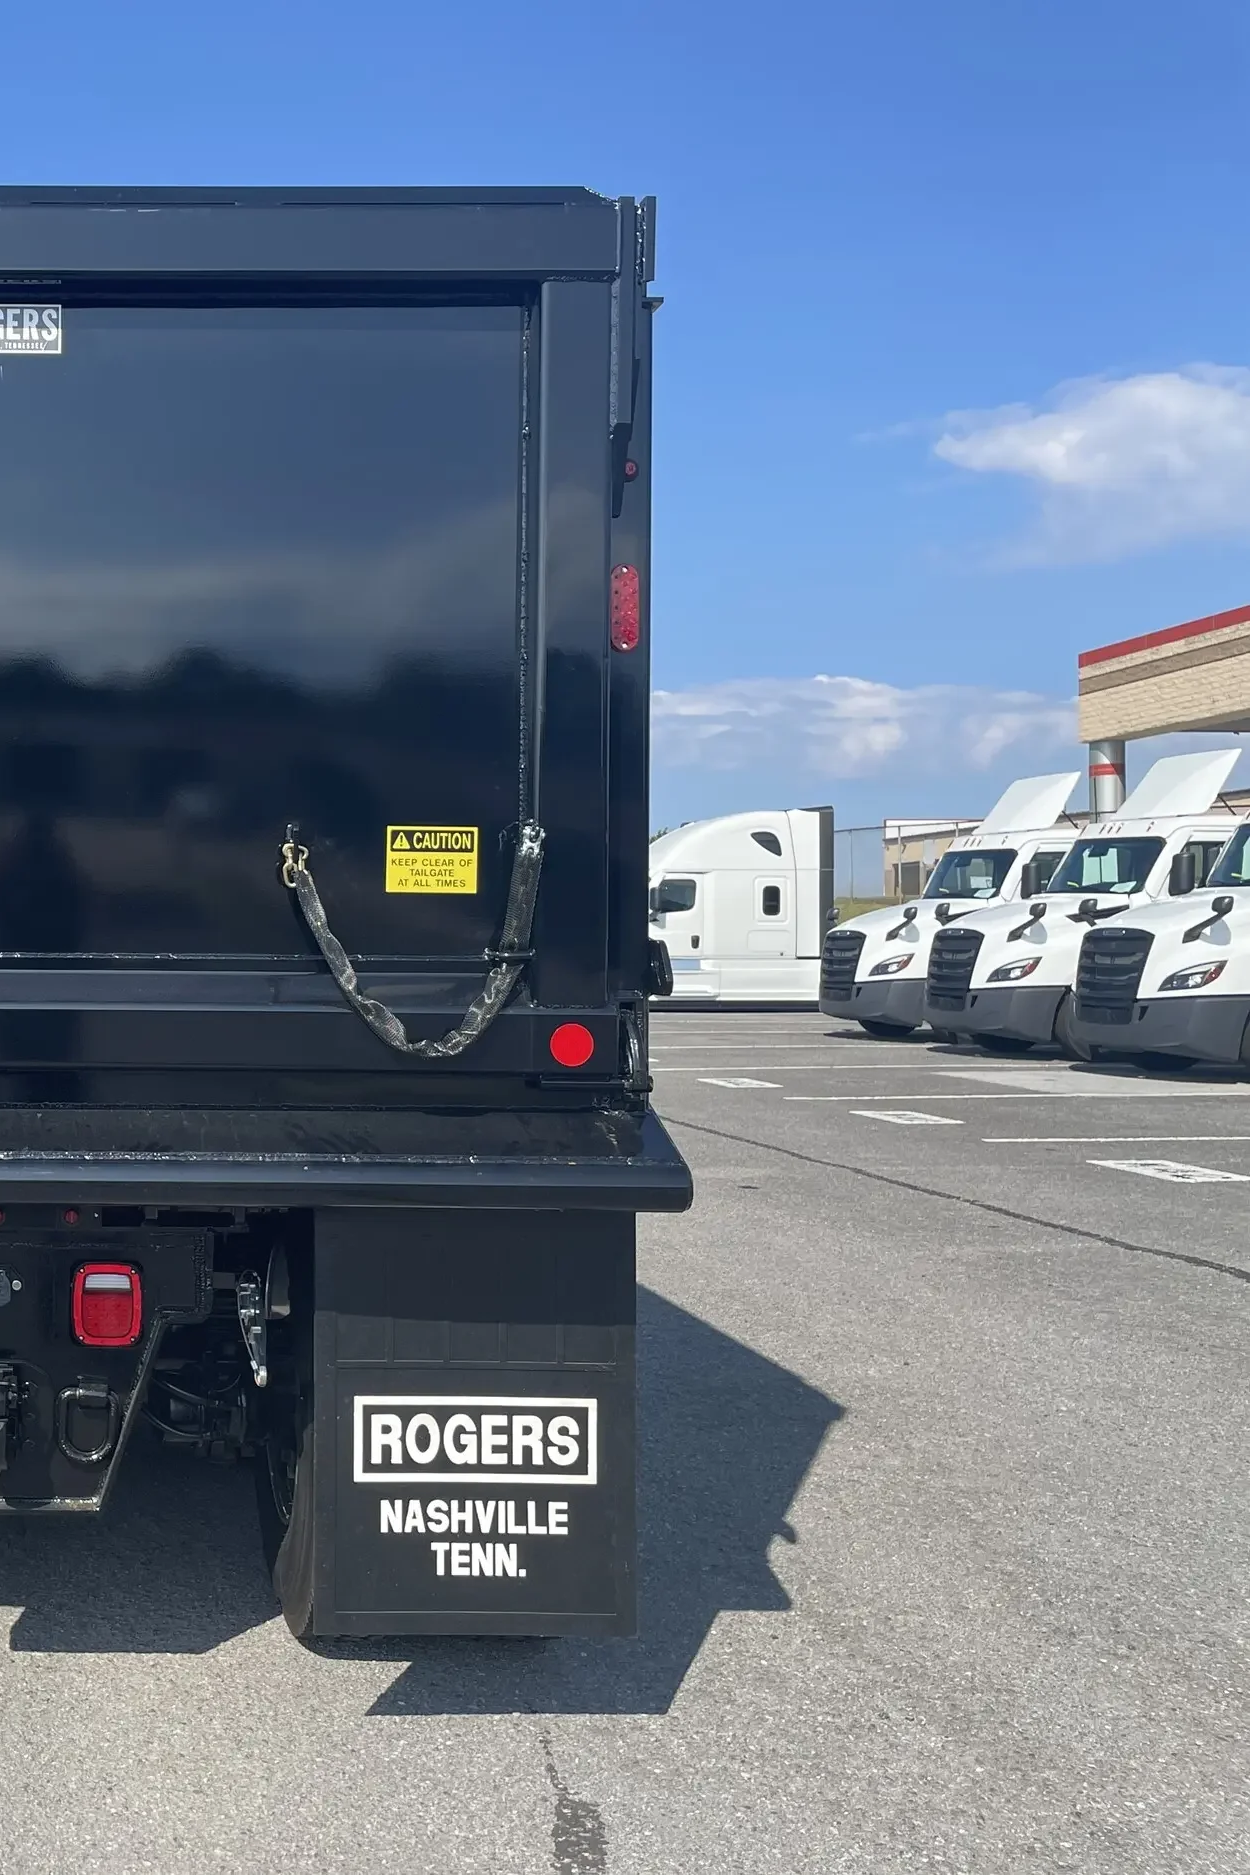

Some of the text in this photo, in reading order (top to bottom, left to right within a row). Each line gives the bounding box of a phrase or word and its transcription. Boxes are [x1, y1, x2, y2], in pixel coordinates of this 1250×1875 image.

[4, 341, 43, 350] TENNESSEE
[413, 832, 471, 849] CAUTION
[391, 858, 473, 867] KEEP CLEAR OF
[410, 869, 455, 878] TAILGATE
[397, 879, 466, 888] AT ALL TIMES
[370, 1413, 580, 1466] ROGERS
[380, 1499, 569, 1535] NASHVILLE
[431, 1542, 527, 1577] TENN.
